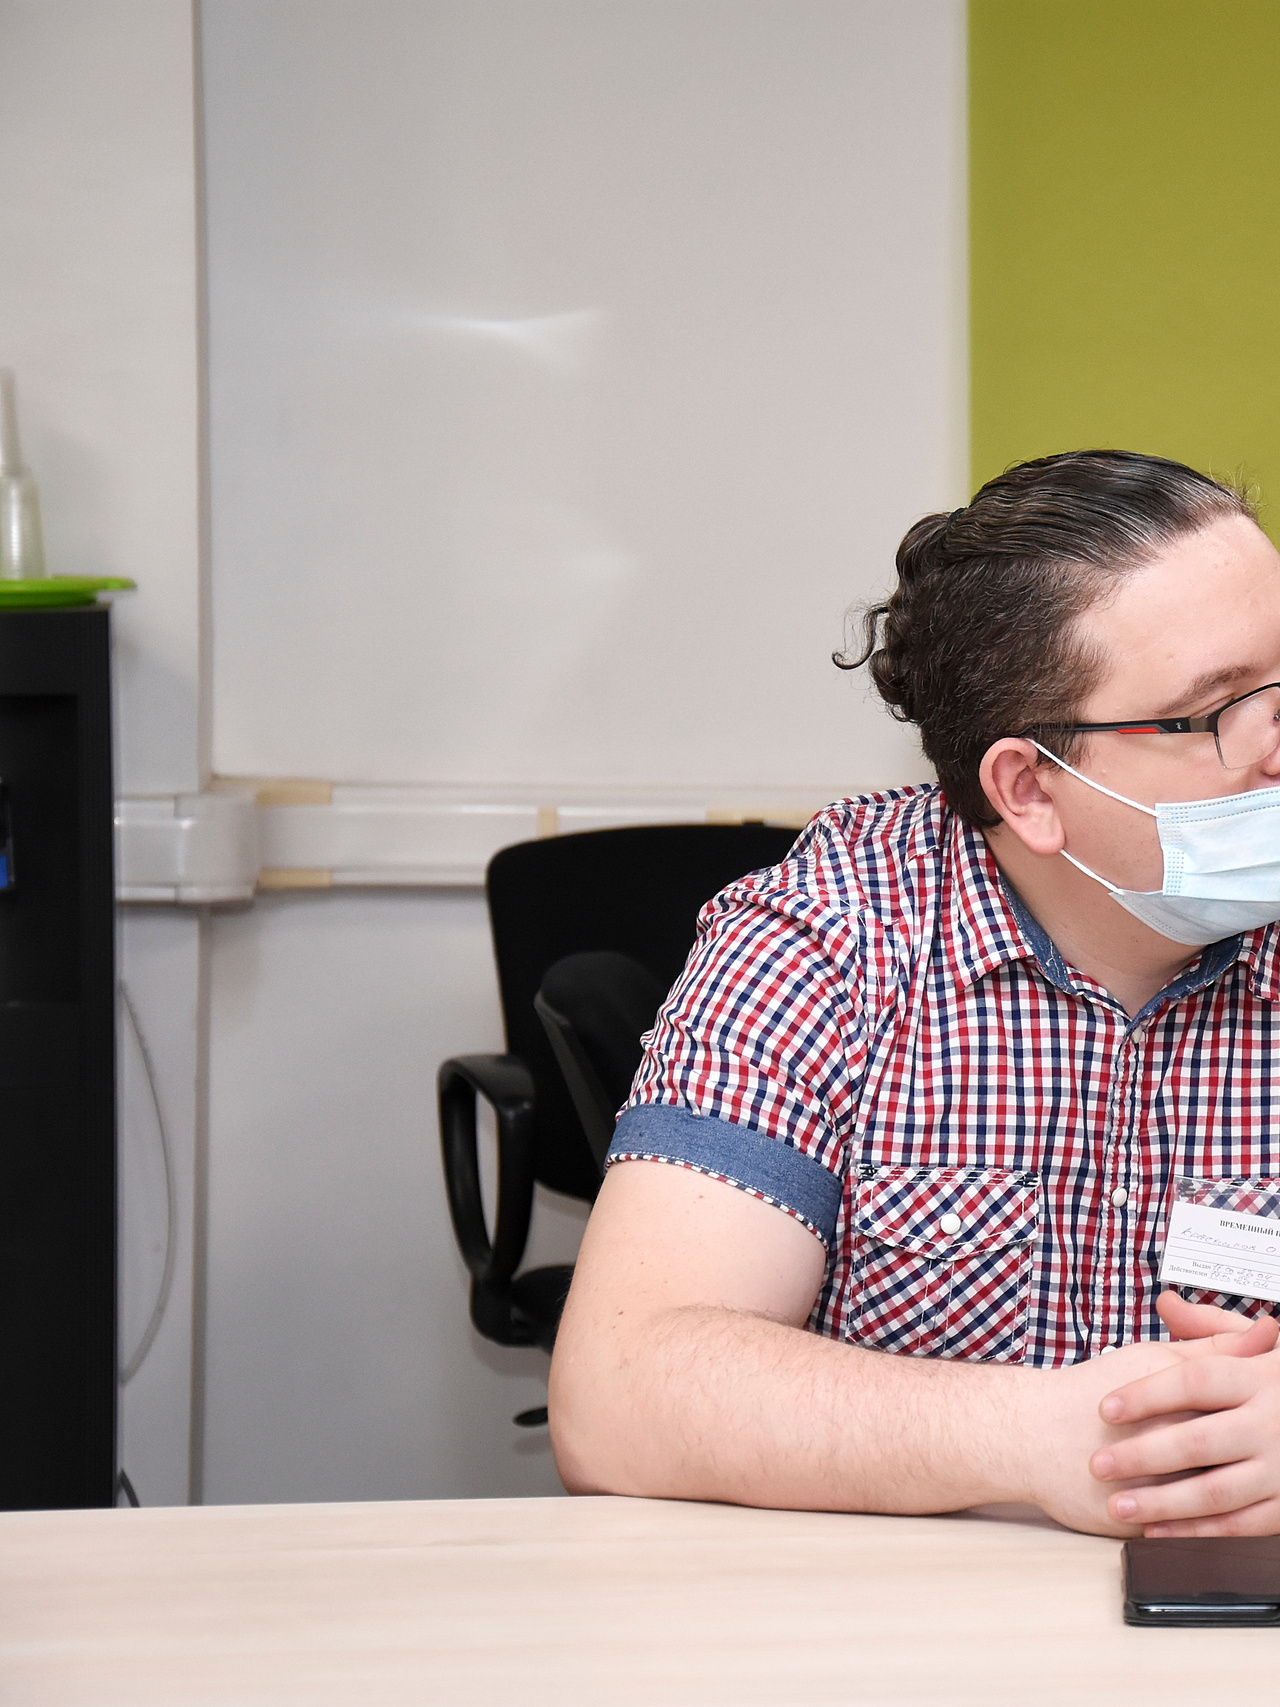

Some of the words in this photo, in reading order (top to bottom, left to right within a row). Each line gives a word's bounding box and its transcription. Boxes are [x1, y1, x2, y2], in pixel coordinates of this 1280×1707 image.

[1219, 1219, 1274, 1236] ВРЕМЕННЫЙ
[1168, 1264, 1208, 1277] Действителен
[1192, 1261, 1211, 1270] Выдан
